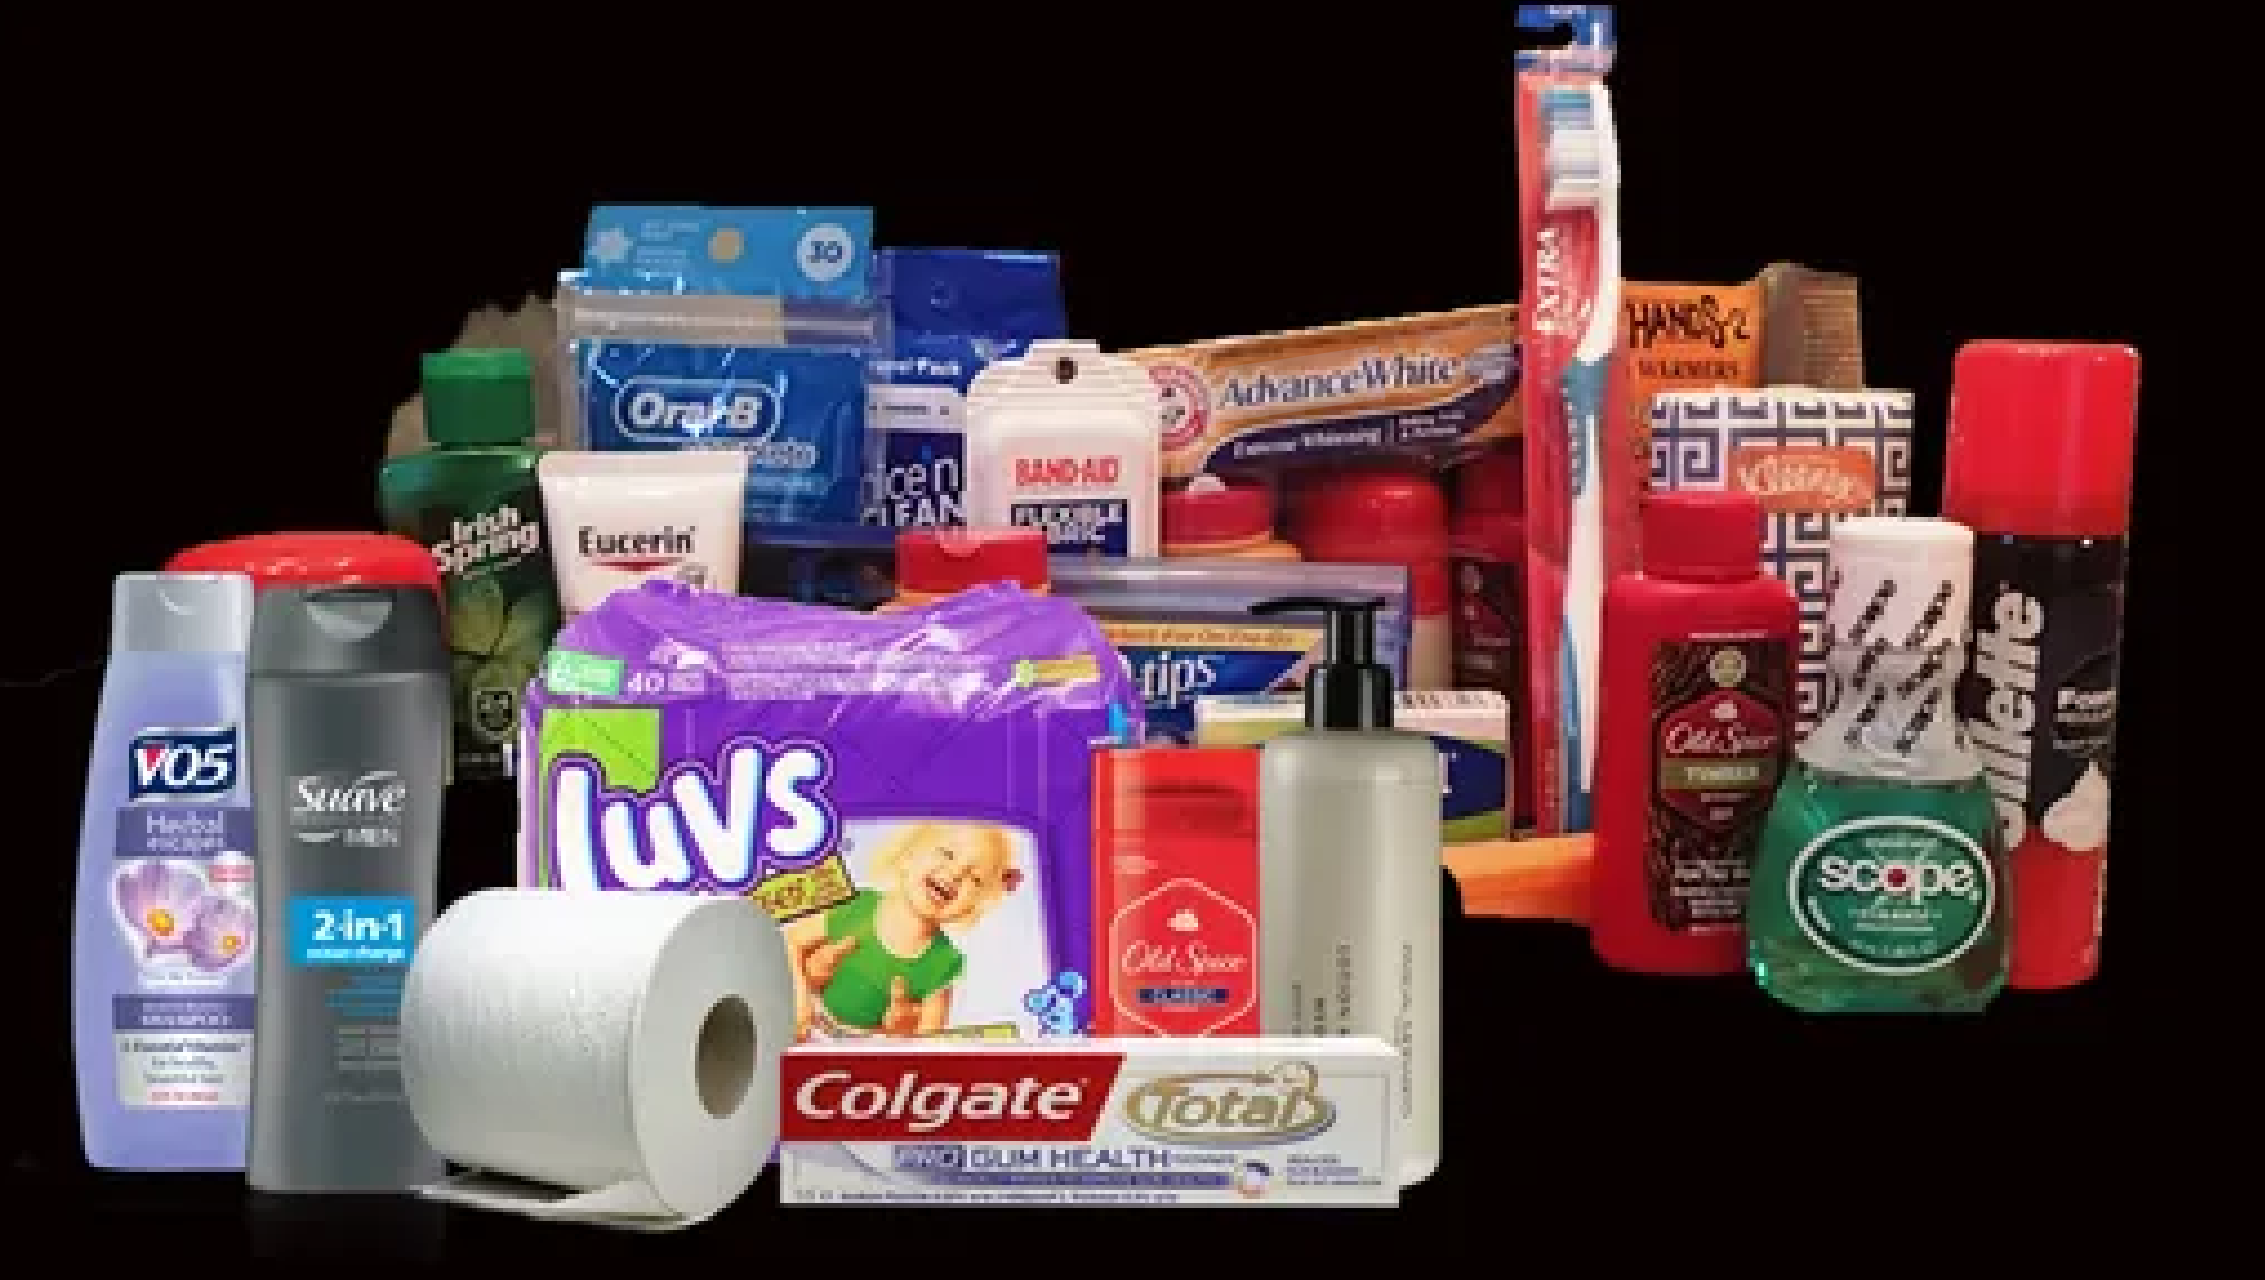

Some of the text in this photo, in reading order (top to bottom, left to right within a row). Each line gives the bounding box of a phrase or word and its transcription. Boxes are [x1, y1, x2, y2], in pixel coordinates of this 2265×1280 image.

[808, 241, 843, 264] 30
[1221, 353, 1460, 409] AdvanceWhite
[1015, 456, 1120, 487] BAND-AID
[452, 504, 521, 543] Irish
[579, 527, 690, 556] Eucerin
[431, 522, 540, 575] Spring
[626, 671, 665, 694] 40
[1666, 722, 1716, 756] Old
[136, 743, 232, 786] VO5
[294, 770, 406, 813] Suave
[1817, 853, 1976, 906] scope
[1121, 938, 1247, 978] Old Spice
[795, 1072, 1081, 1133] Colgate
[1150, 1079, 1302, 1131] Total
[971, 1148, 1041, 1170] GUM
[1049, 1148, 1170, 1170] HEALTH
